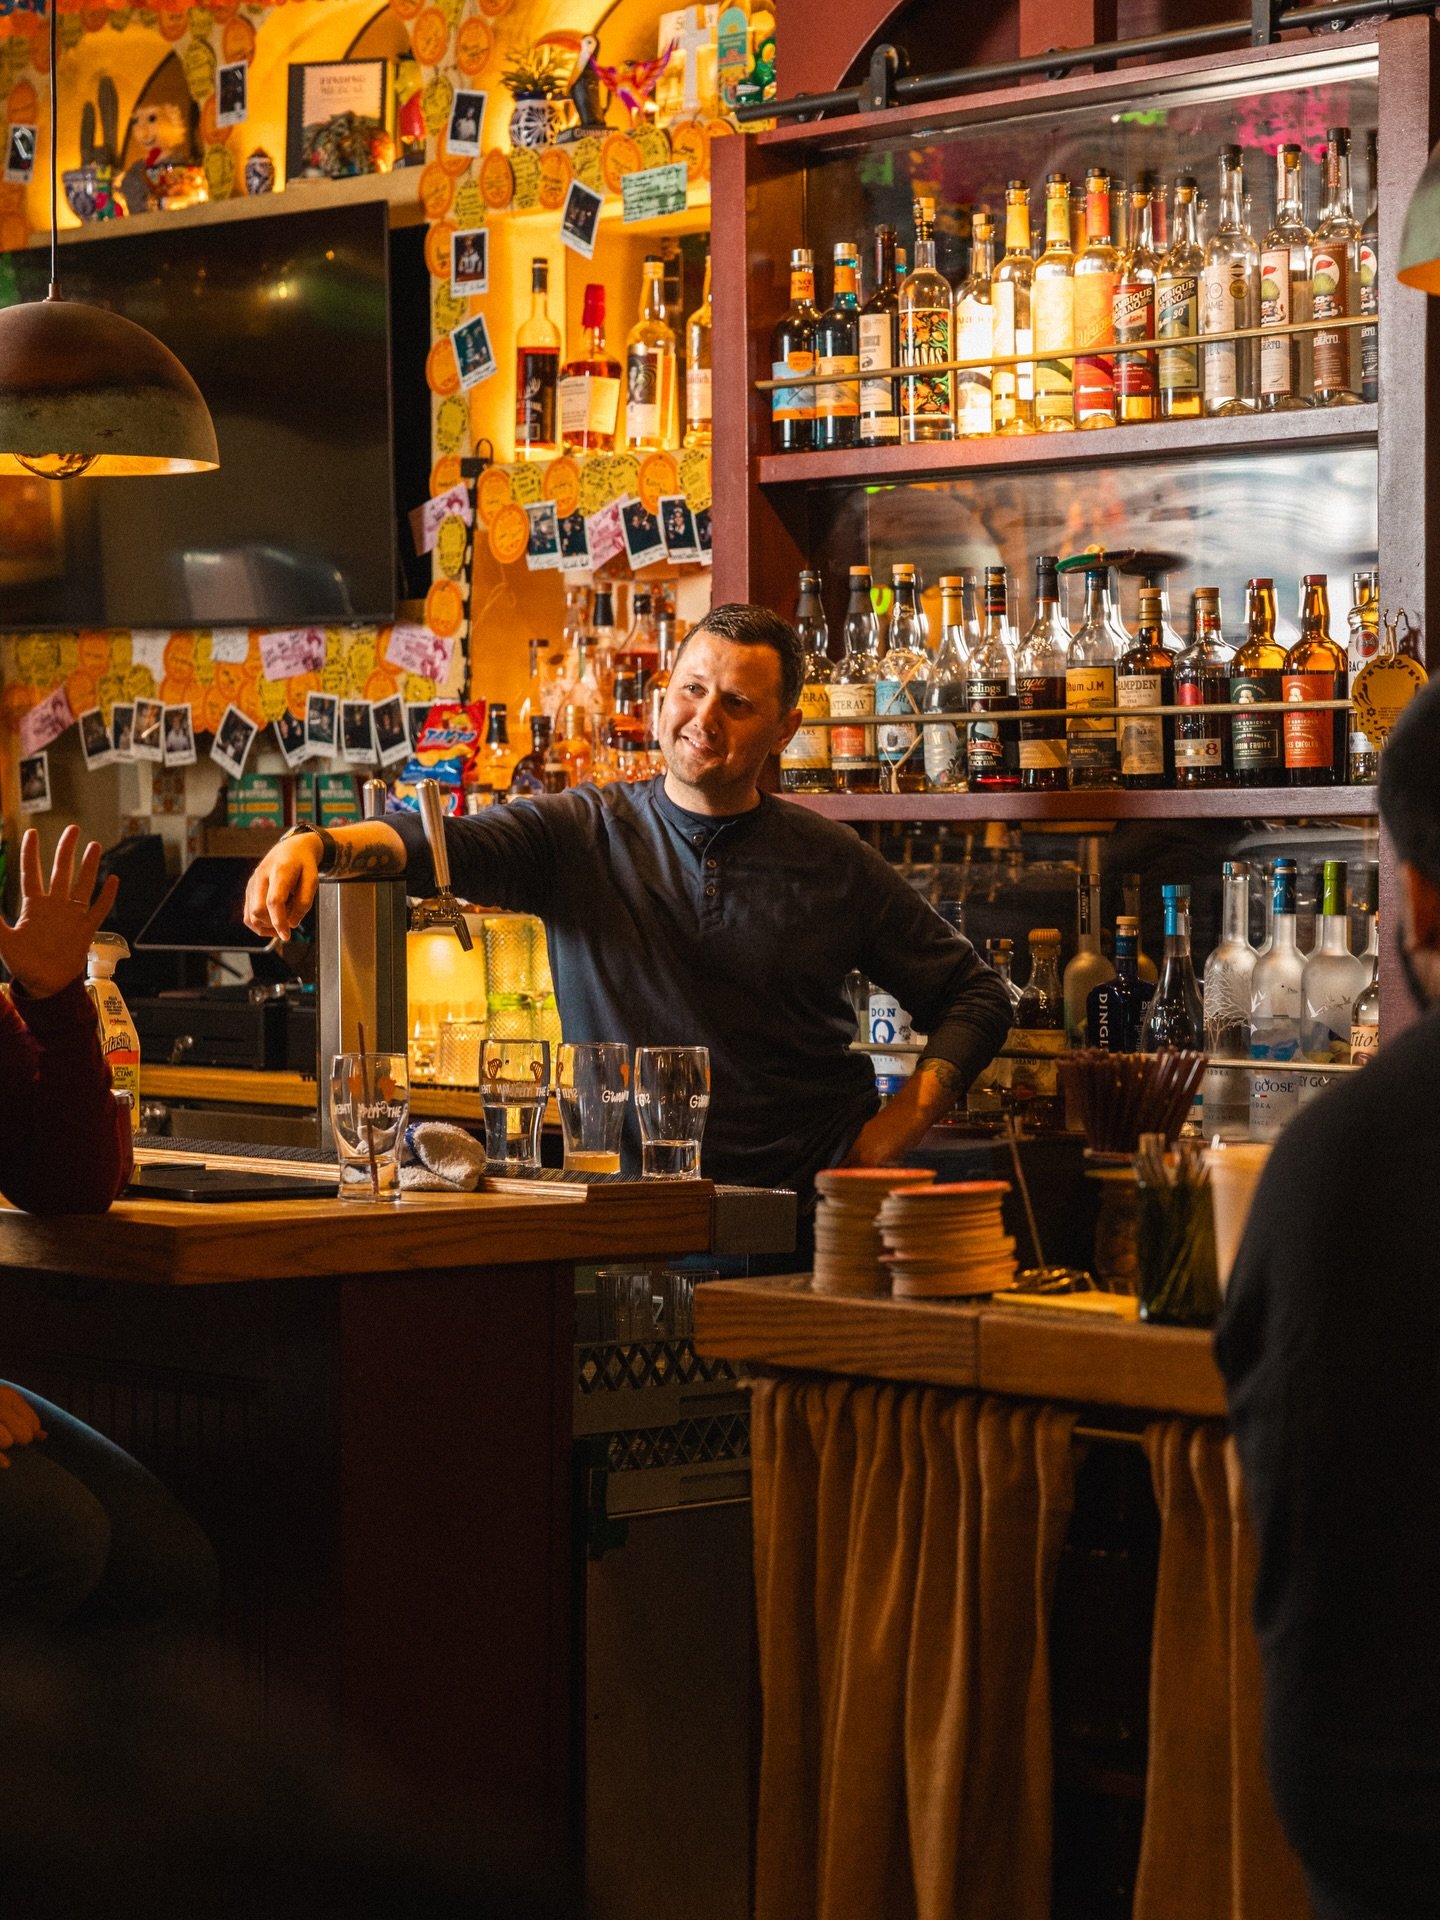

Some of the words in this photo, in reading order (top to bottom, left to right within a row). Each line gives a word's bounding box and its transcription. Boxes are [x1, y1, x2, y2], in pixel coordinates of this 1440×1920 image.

[1086, 681, 1104, 692] J.M
[1205, 742, 1218, 756] 8
[871, 1007, 896, 1018] DON
[1254, 1081, 1294, 1093] GOOSE
